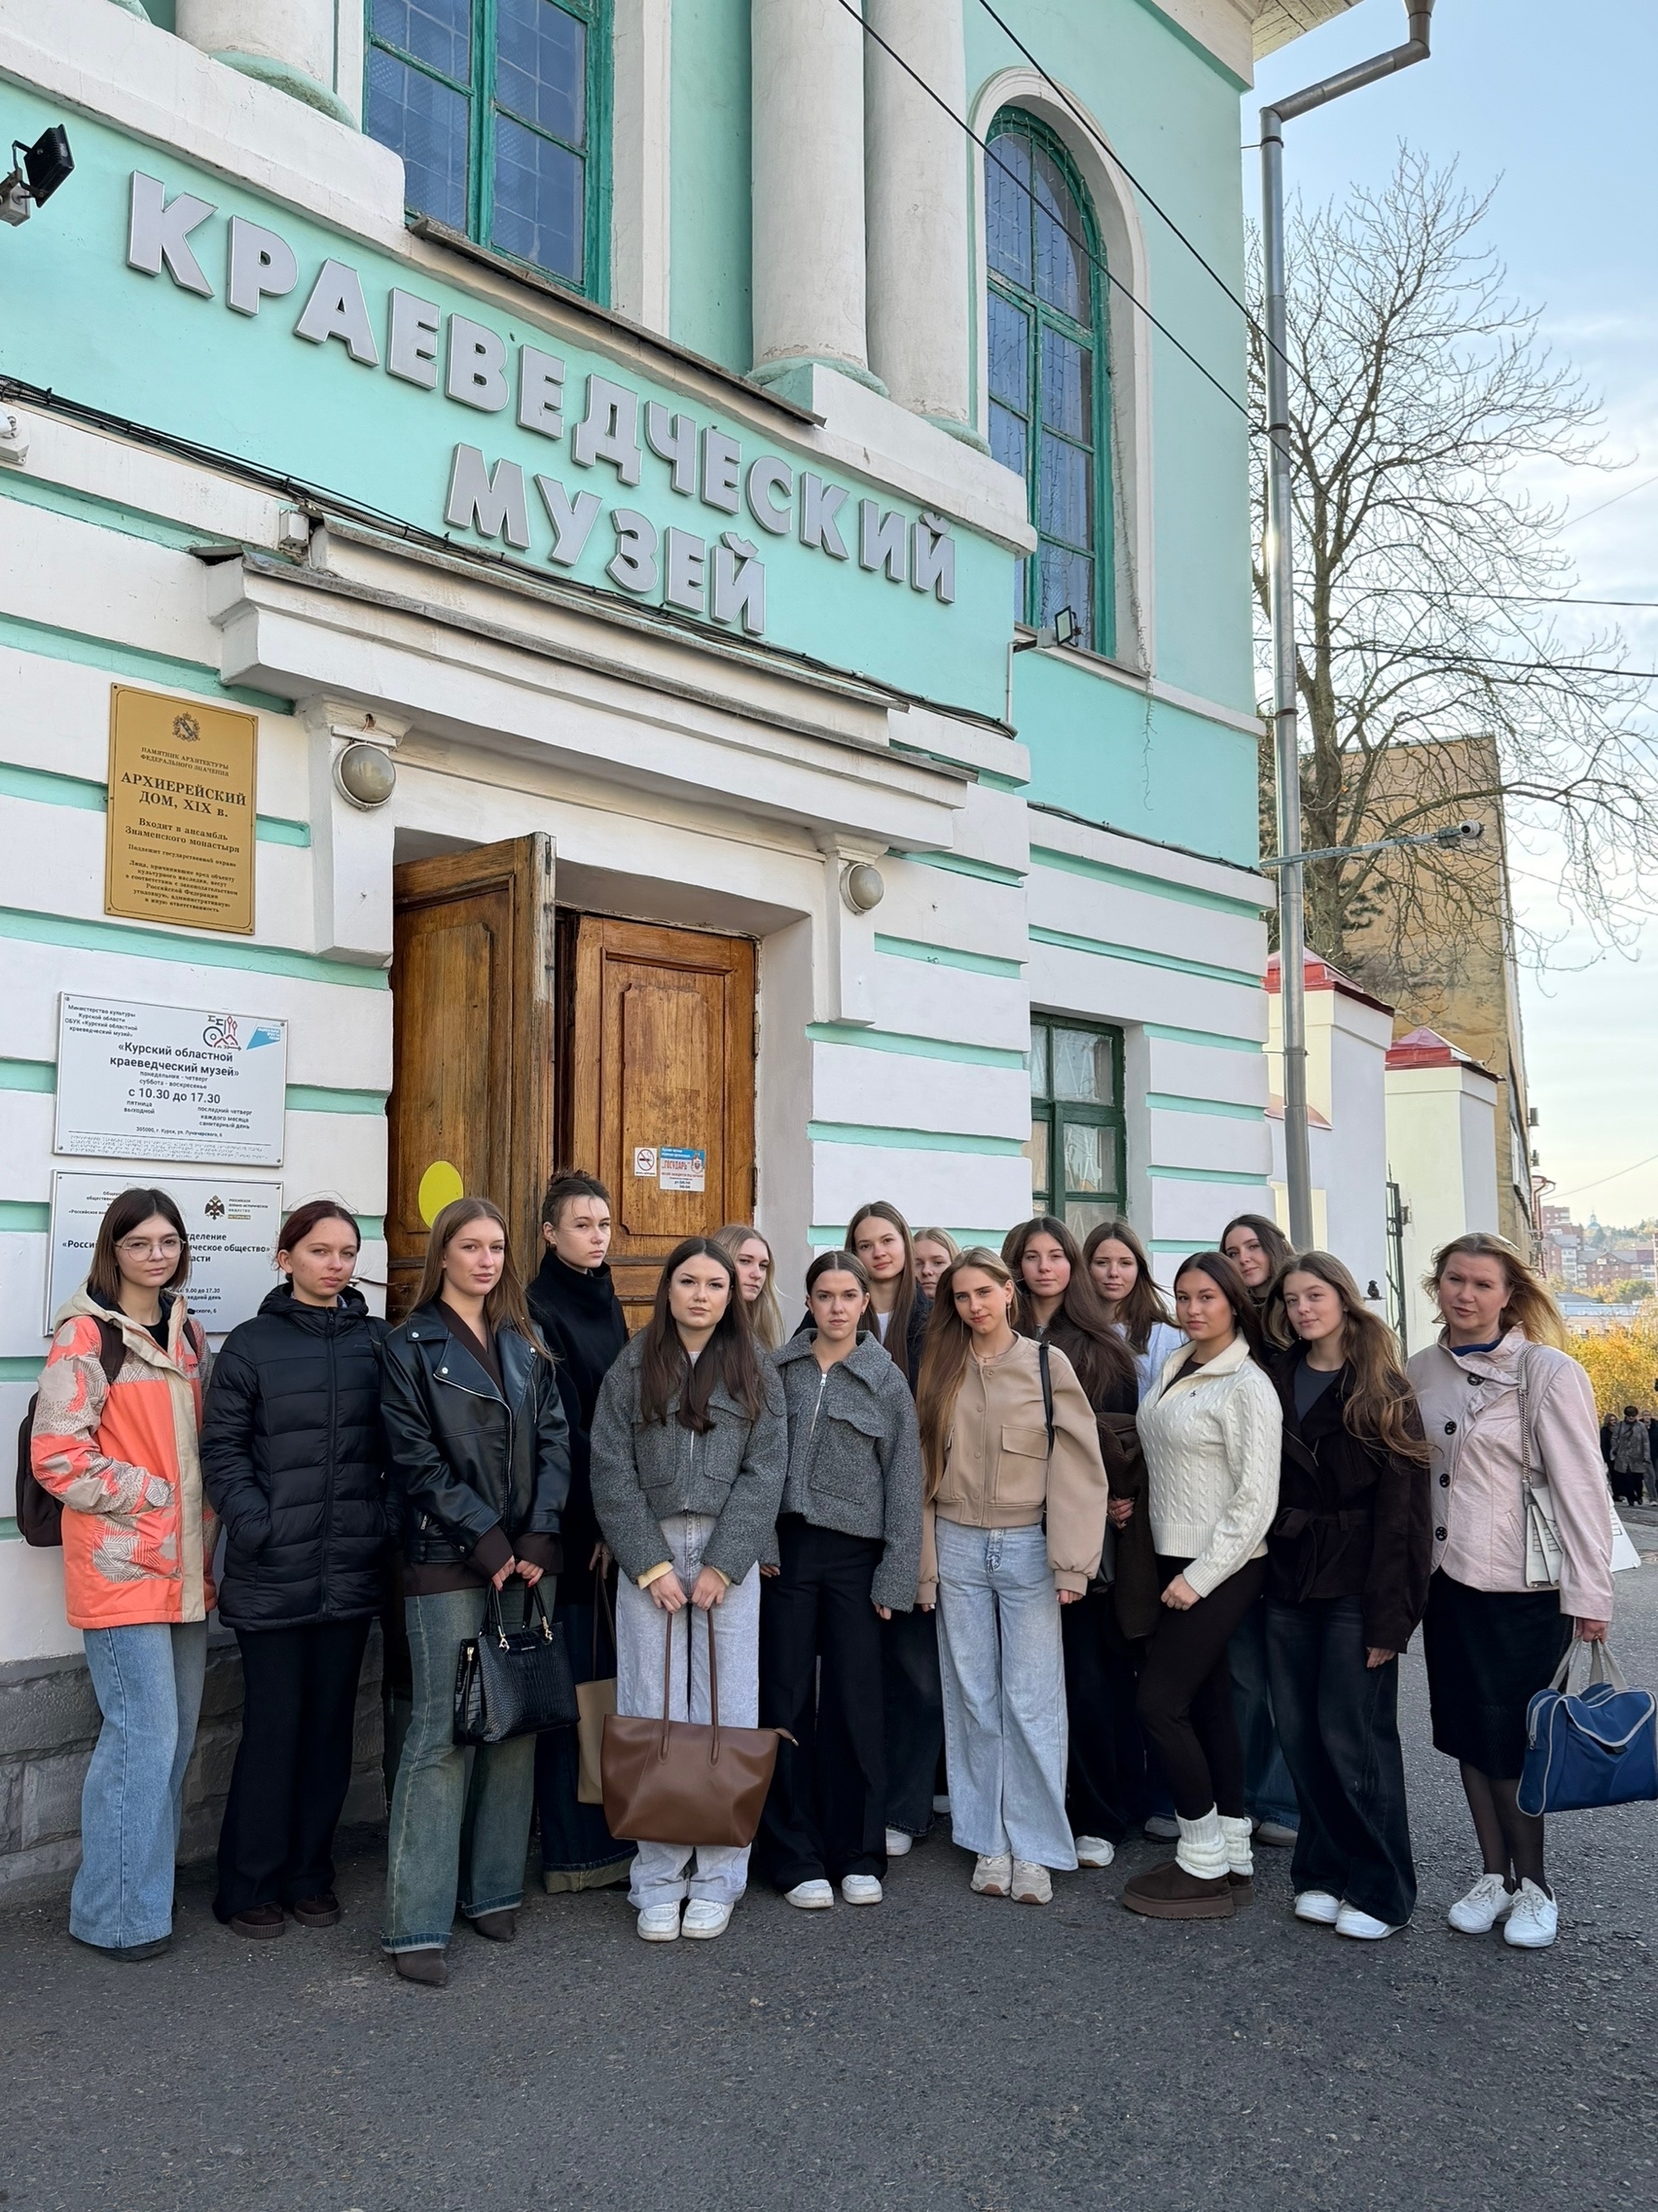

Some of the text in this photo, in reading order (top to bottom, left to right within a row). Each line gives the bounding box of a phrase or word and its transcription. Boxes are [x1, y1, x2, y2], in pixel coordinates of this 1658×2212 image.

[127, 170, 956, 604] КРАЕВЕДЧЕСКИЙ
[444, 442, 765, 634] МУЗЕЙ
[140, 754, 229, 777] ФЕДЕРАЛЬНОГО ЗНАЧЕНИЯ
[141, 747, 229, 770] ПАМЯТНИК АРХИТЕКТУРЫ
[120, 772, 246, 805] АРХИЕРЕЙСКИЙ
[139, 791, 228, 817] ДОМ, XIX в.
[125, 825, 240, 853] Знаменского монастыря
[138, 817, 173, 831] Входит
[184, 827, 228, 841] ансамбль
[128, 843, 237, 868] Подлежит государственной охране
[137, 868, 176, 880] культурного
[211, 872, 235, 882] объекту
[67, 1004, 109, 1014] Министерство
[69, 1026, 112, 1035] краеведческий
[118, 1041, 233, 1062] «Курский областной
[110, 1057, 239, 1077] краеведческий музей»
[140, 1071, 180, 1079] понедельник
[139, 1078, 164, 1087] суббота
[138, 1088, 170, 1100] 10.30
[173, 1092, 187, 1103] до
[191, 1092, 220, 1104] 17.30
[199, 1120, 235, 1128] санитарный
[62, 1239, 95, 1249] «Росси
[225, 1243, 270, 1253] общество»
